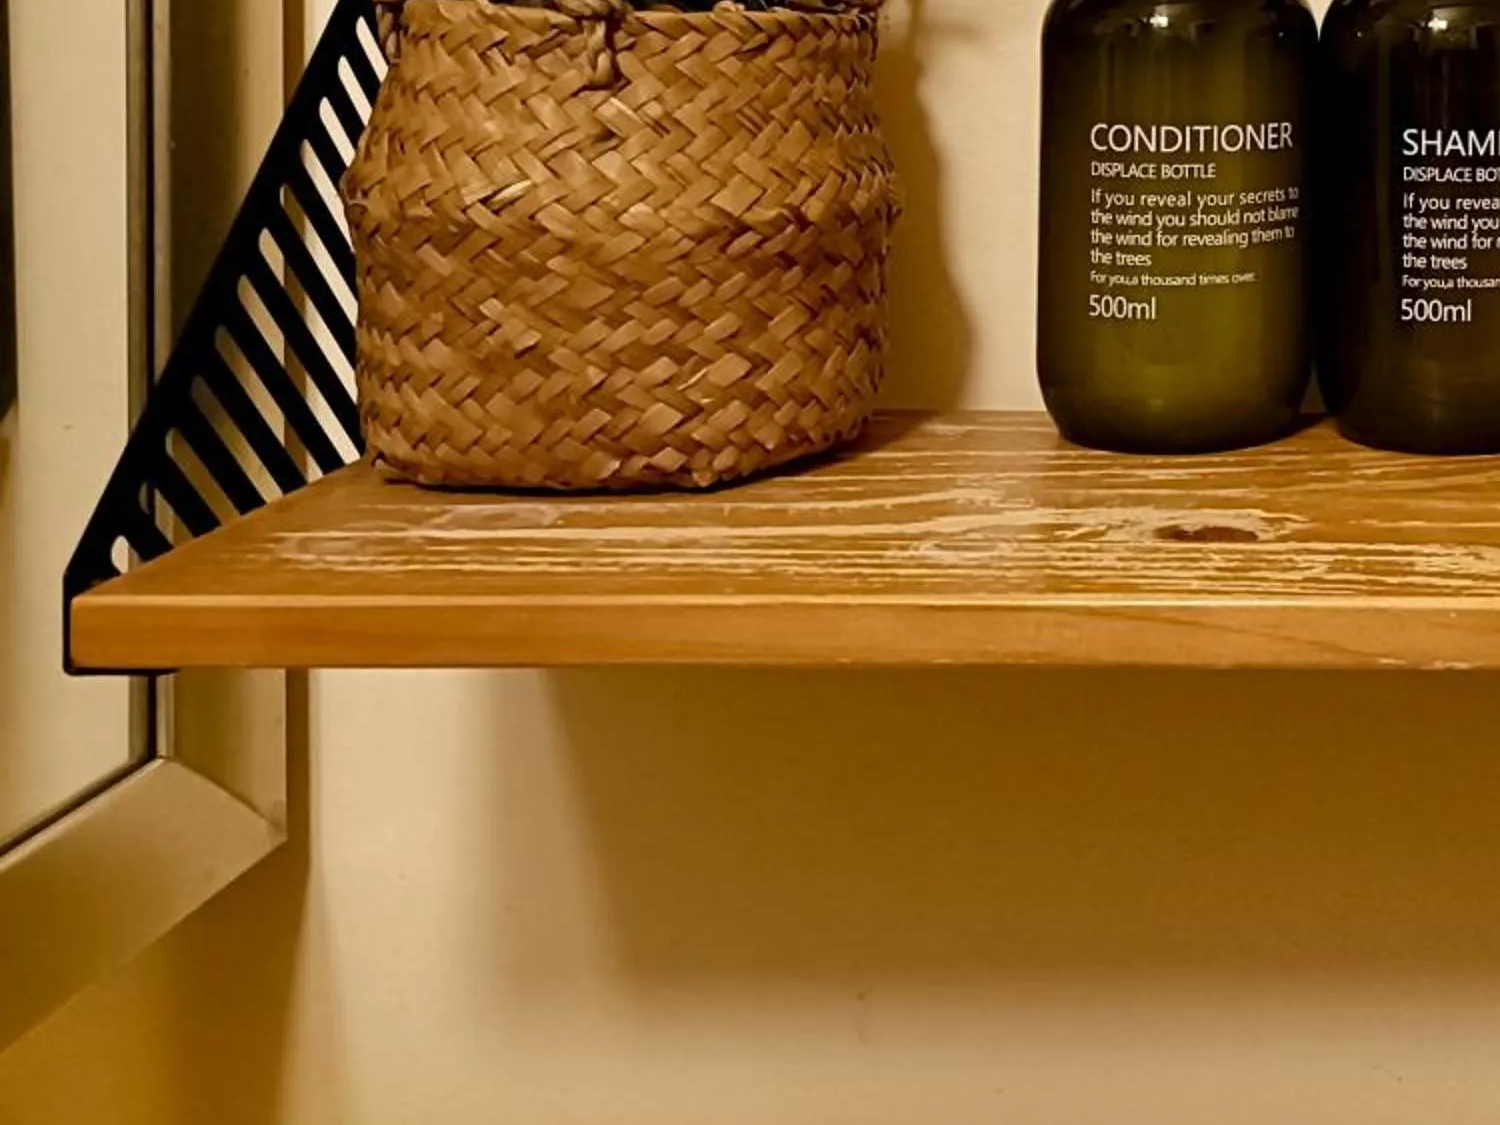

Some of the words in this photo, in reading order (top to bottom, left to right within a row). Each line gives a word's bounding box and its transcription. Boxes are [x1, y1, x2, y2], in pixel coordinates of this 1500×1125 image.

[1090, 122, 1293, 153] CONDITIONER
[1091, 161, 1157, 179] DISPLACE
[1161, 163, 1217, 179] BOTTLE
[1402, 166, 1473, 183] DISPLACE
[1091, 187, 1101, 204] If
[1104, 192, 1135, 209] you
[1140, 190, 1191, 207] reveal
[1197, 193, 1235, 210] your
[1239, 187, 1286, 205] secrets
[1287, 186, 1300, 200] to
[1403, 191, 1415, 209] If
[1418, 197, 1450, 214] you
[1090, 208, 1113, 225] the
[1115, 210, 1153, 226] wind
[1155, 214, 1185, 232] you
[1189, 207, 1241, 227] should
[1243, 208, 1266, 224] not
[1403, 212, 1427, 229] the
[1430, 213, 1468, 230] wind
[1471, 217, 1499, 234] you
[1090, 228, 1113, 245] the
[1115, 229, 1153, 246] wind
[1156, 230, 1179, 247] for
[1182, 228, 1249, 249] revealing
[1251, 227, 1283, 244] them
[1284, 225, 1295, 238] to
[1403, 232, 1427, 249] the
[1430, 233, 1468, 250] wind
[1472, 233, 1493, 250] for
[1090, 247, 1113, 265] the
[1115, 251, 1153, 266] trees
[1402, 251, 1427, 269] the
[1430, 254, 1468, 270] trees
[1141, 272, 1197, 286] thousand
[1199, 273, 1230, 285] times
[1088, 294, 1157, 320] 500ml
[1400, 298, 1472, 323] 500ml
